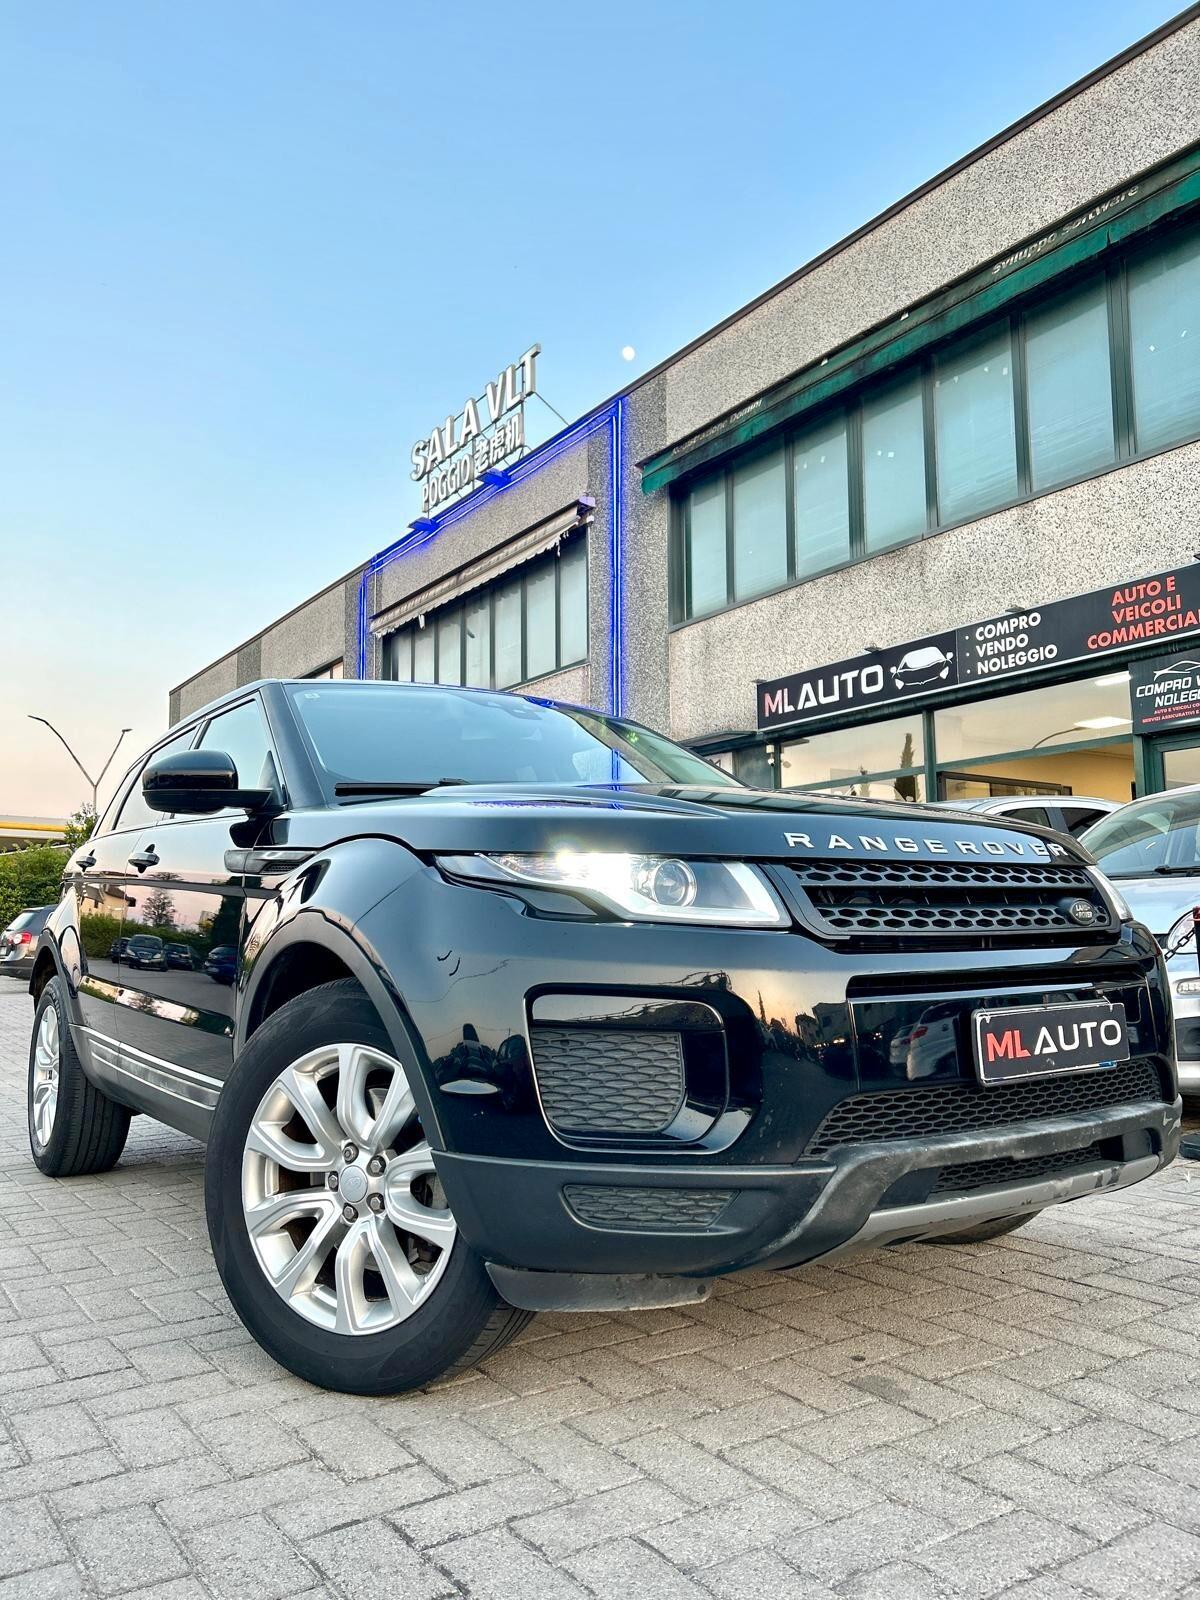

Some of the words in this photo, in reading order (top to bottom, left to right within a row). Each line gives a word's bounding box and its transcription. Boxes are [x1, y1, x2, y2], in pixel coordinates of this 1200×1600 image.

[410, 397, 481, 482] SALA
[486, 343, 541, 423] VLT
[422, 453, 474, 513] POGGIO
[1111, 580, 1162, 607] AUTO
[1166, 575, 1176, 592] E
[1111, 594, 1182, 624] VEICOLI
[975, 612, 1041, 641] COMPRO
[1087, 608, 1200, 650] COMMERCIA
[975, 633, 1029, 658] VENDO
[977, 644, 1058, 675] NOLEGGIO
[1136, 677, 1192, 697] COMPRO
[783, 832, 948, 854] RANGE
[954, 840, 1068, 857] ROVER
